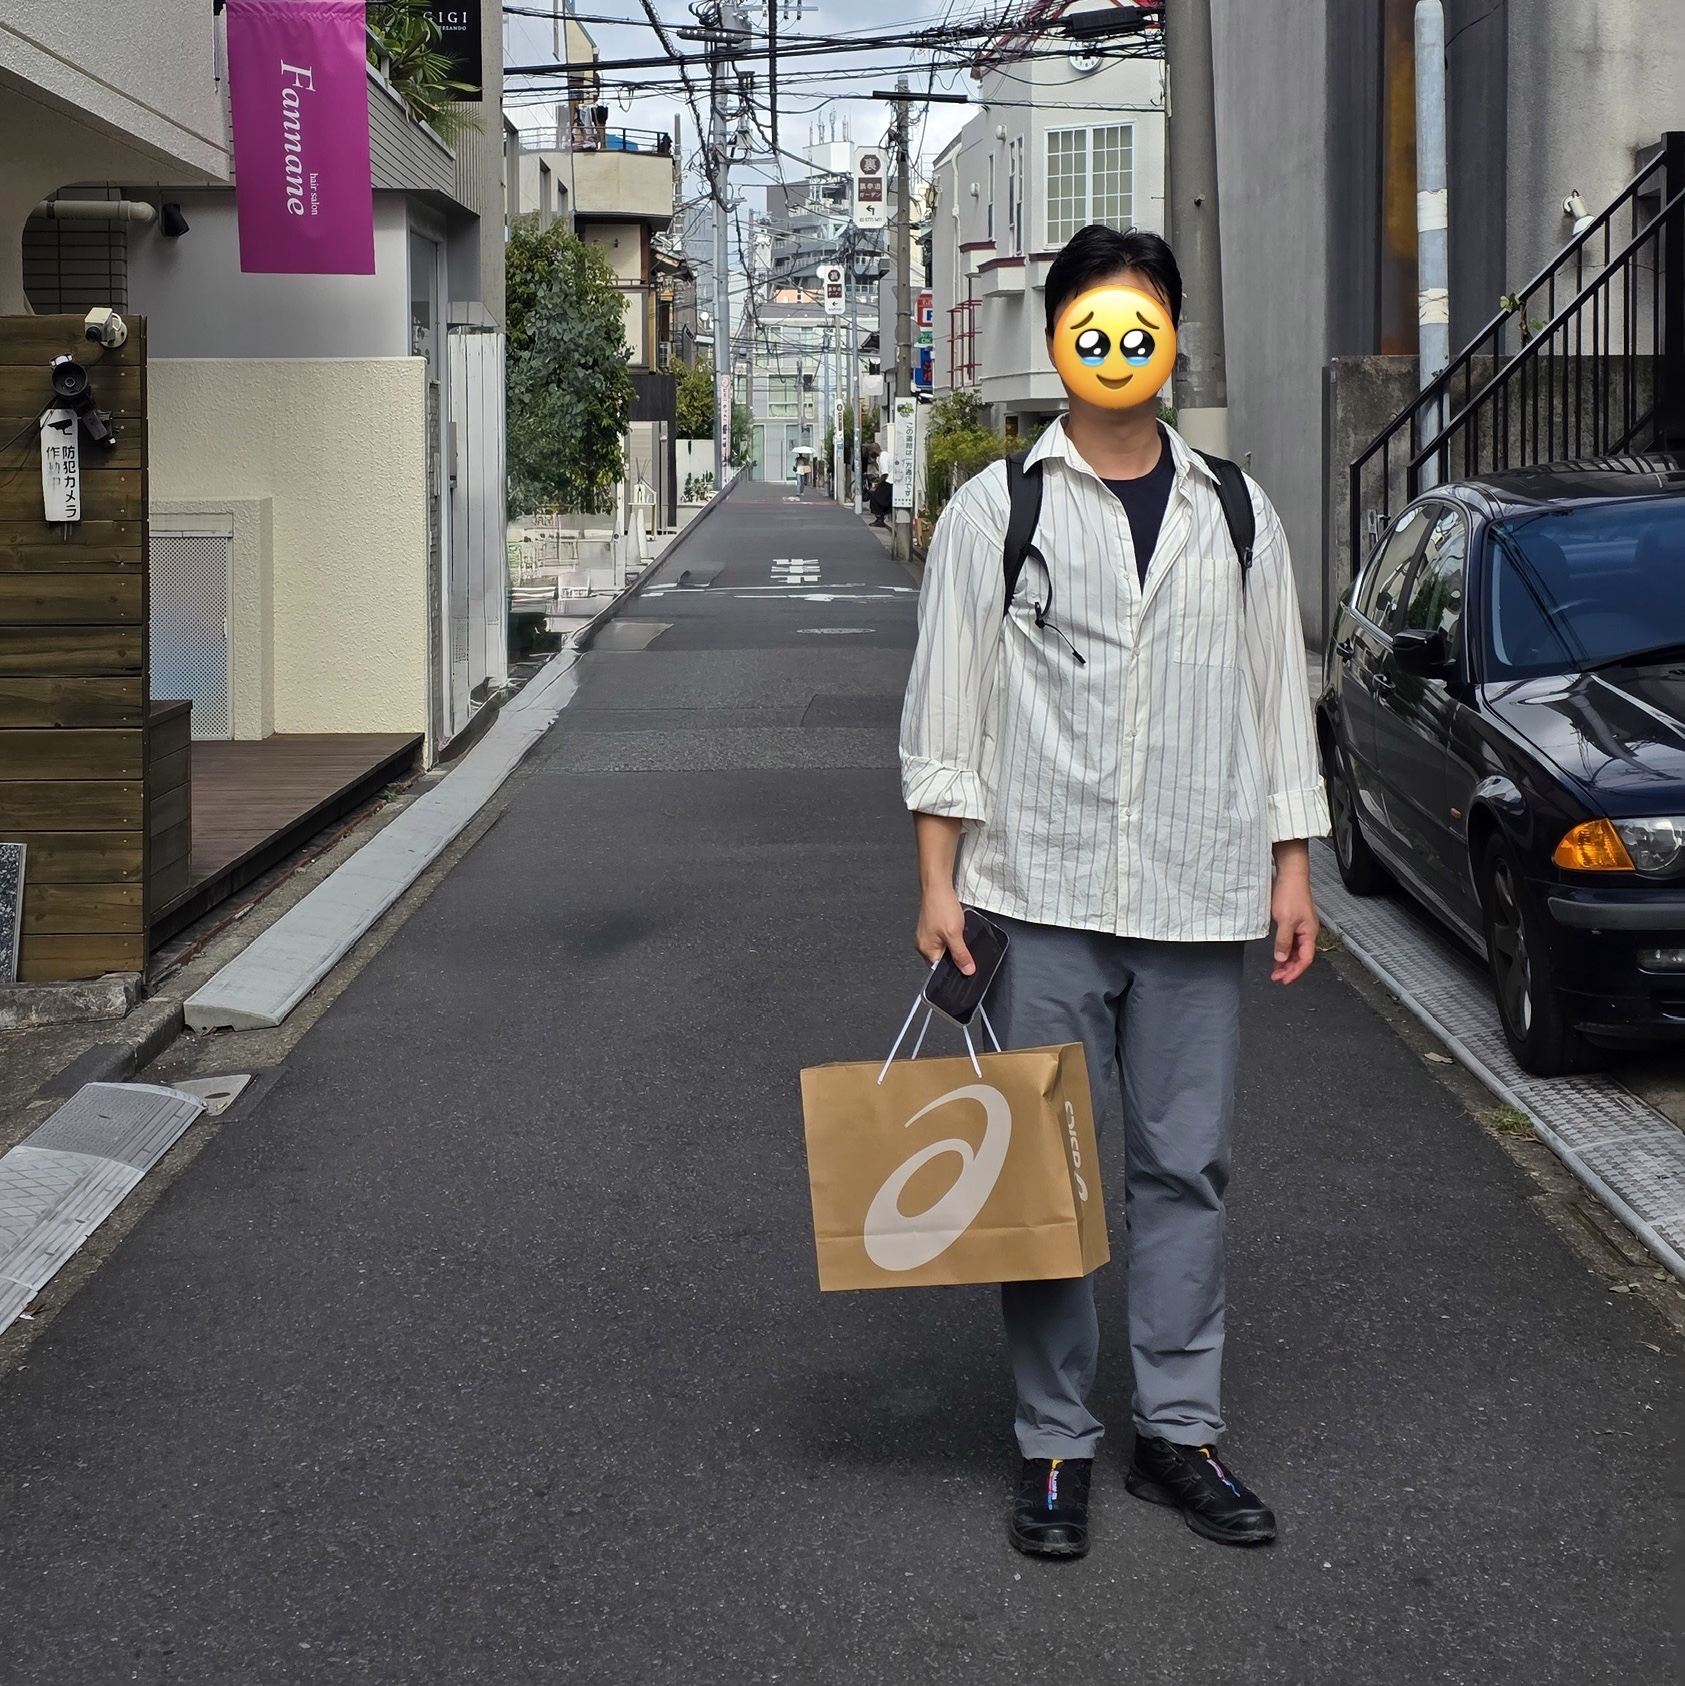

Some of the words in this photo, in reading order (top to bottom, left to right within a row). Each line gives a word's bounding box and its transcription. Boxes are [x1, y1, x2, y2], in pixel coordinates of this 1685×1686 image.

[423, 11, 467, 23] GIGI
[280, 59, 316, 216] Fannane
[309, 172, 319, 190] hair
[310, 192, 320, 215] salon
[62, 446, 77, 518] 防犯カメラ
[1064, 1100, 1081, 1168] asics
